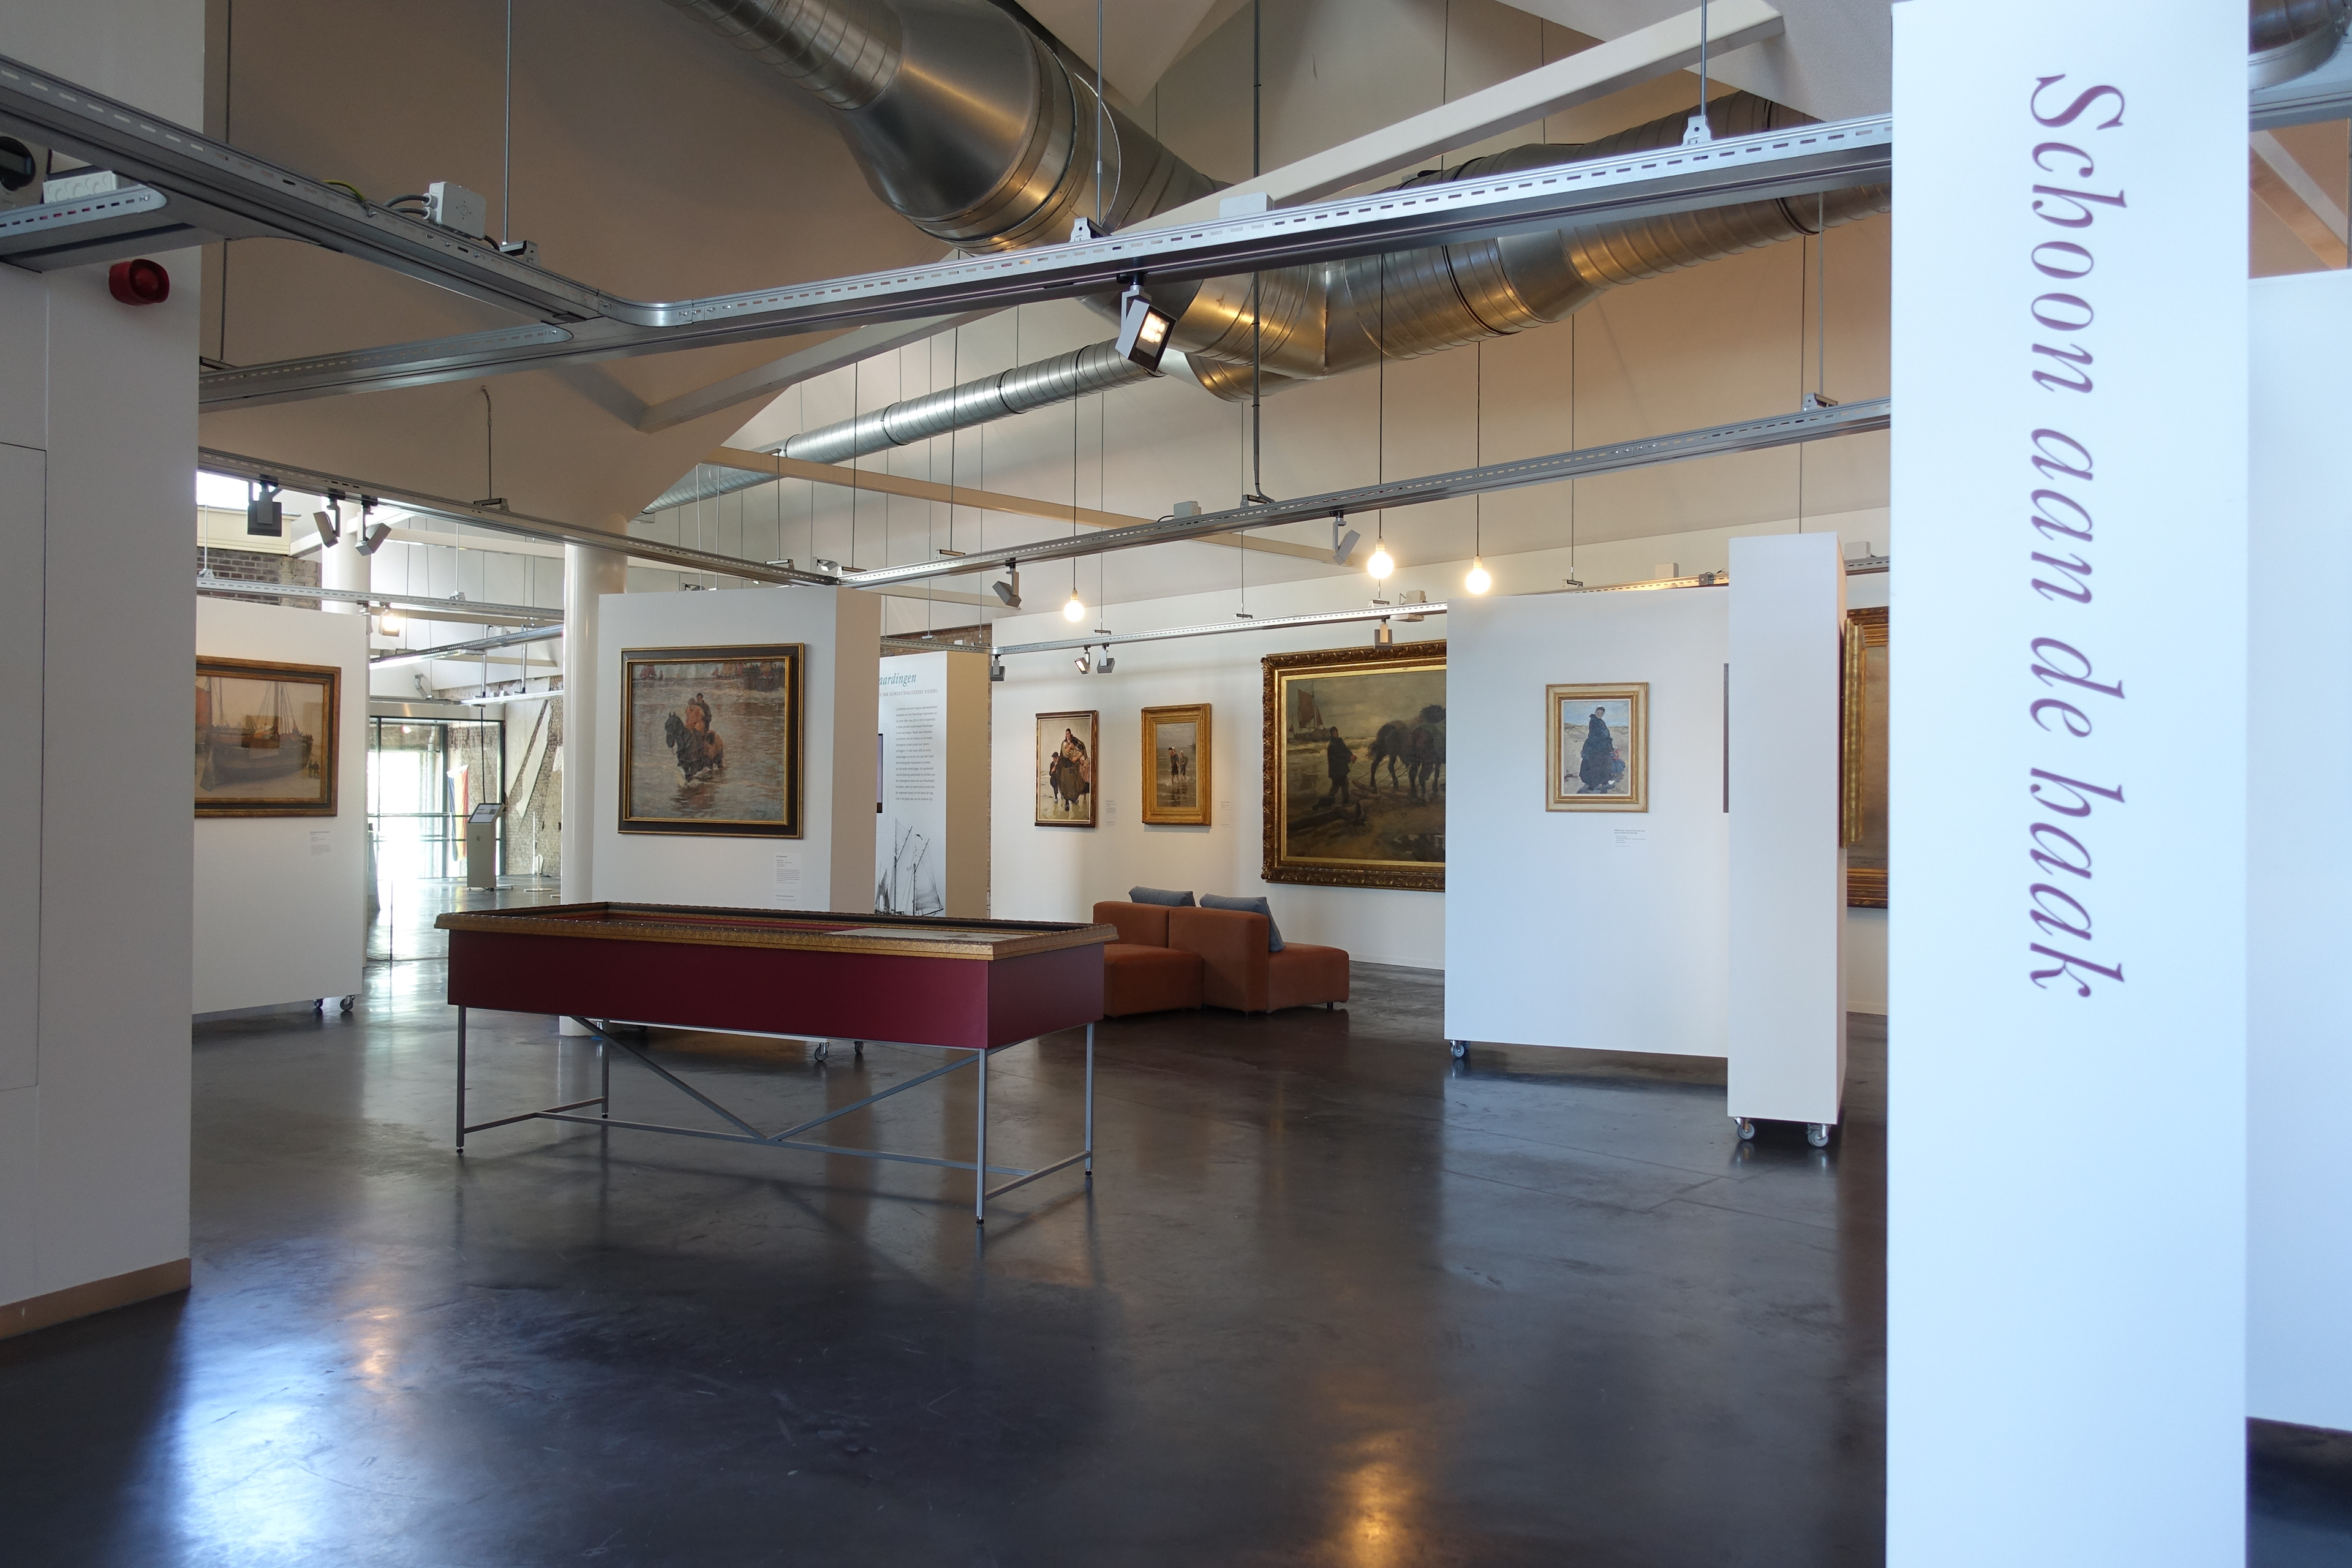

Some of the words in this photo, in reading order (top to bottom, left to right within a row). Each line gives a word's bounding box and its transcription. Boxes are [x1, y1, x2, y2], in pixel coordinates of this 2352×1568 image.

[2029, 73, 2128, 394] Schoon
[2030, 428, 2094, 604] aan
[879, 673, 916, 687] aardingen
[2029, 636, 2125, 738] de
[2028, 766, 2125, 998] haak
